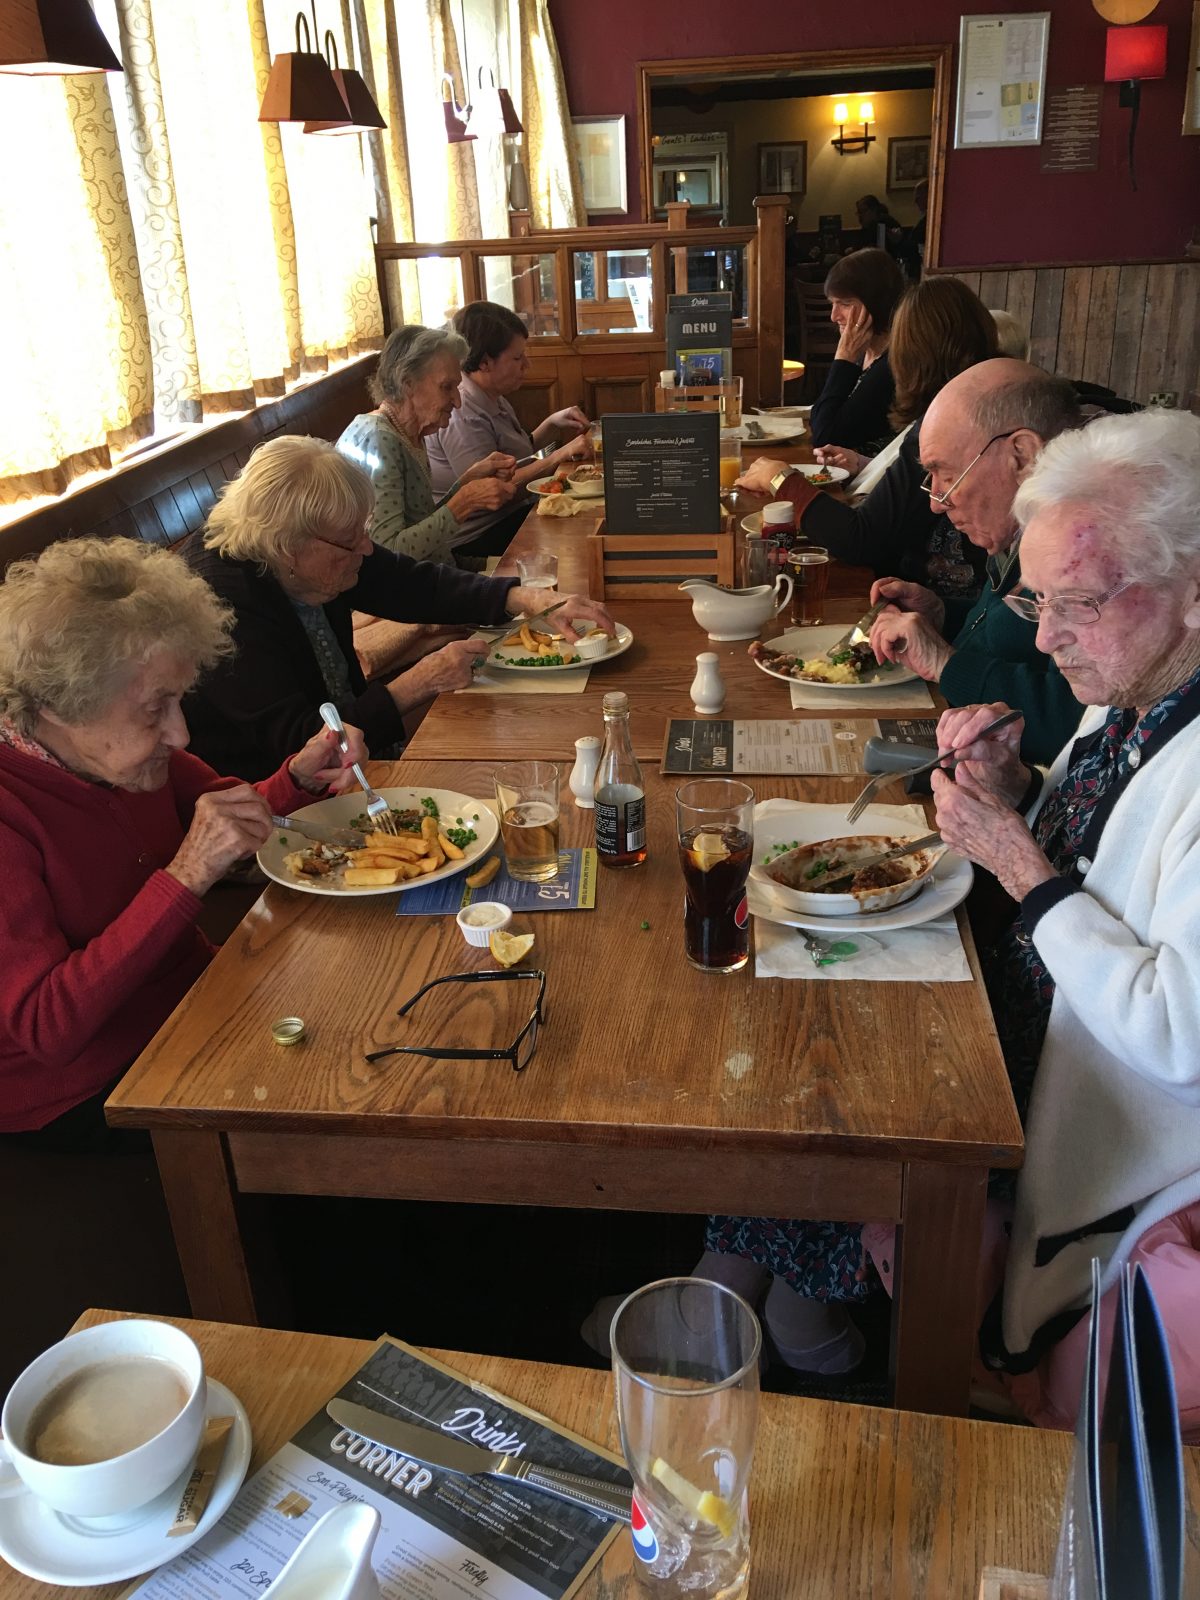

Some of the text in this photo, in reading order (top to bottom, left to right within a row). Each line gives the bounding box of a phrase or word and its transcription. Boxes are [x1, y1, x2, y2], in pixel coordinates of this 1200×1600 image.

[682, 322, 717, 334] MENU
[712, 746, 728, 767] CORNER
[441, 1407, 527, 1457] Drinks
[330, 1428, 433, 1498] CORNER
[306, 1471, 331, 1489] San
[175, 1487, 193, 1523] SUGAR
[250, 1571, 272, 1588] Spr
[459, 1559, 489, 1588] Firefly
